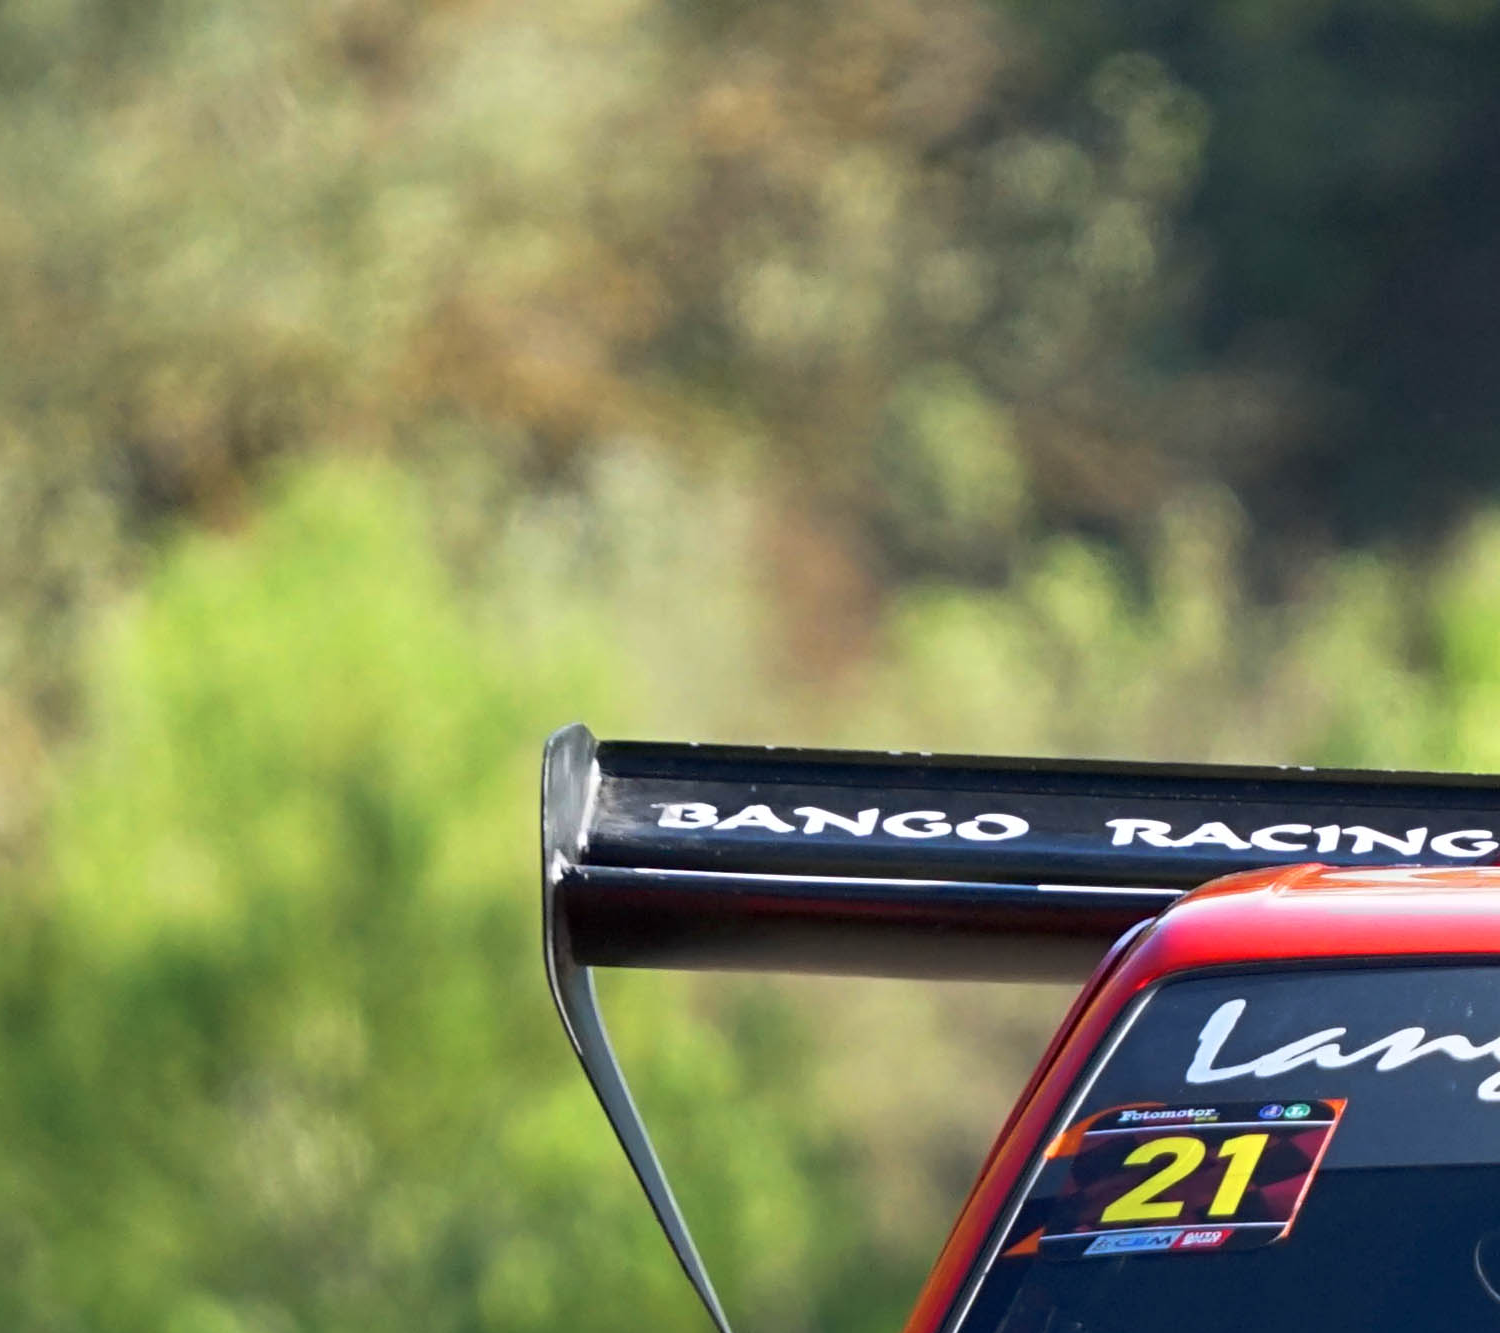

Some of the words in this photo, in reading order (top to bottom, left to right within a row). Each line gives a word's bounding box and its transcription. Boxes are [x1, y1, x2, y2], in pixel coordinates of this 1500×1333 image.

[656, 801, 1029, 841] BANGO
[1106, 817, 1500, 859] RACING
[1117, 1106, 1216, 1123] Fotomotor
[1099, 1134, 1270, 1223] 21
